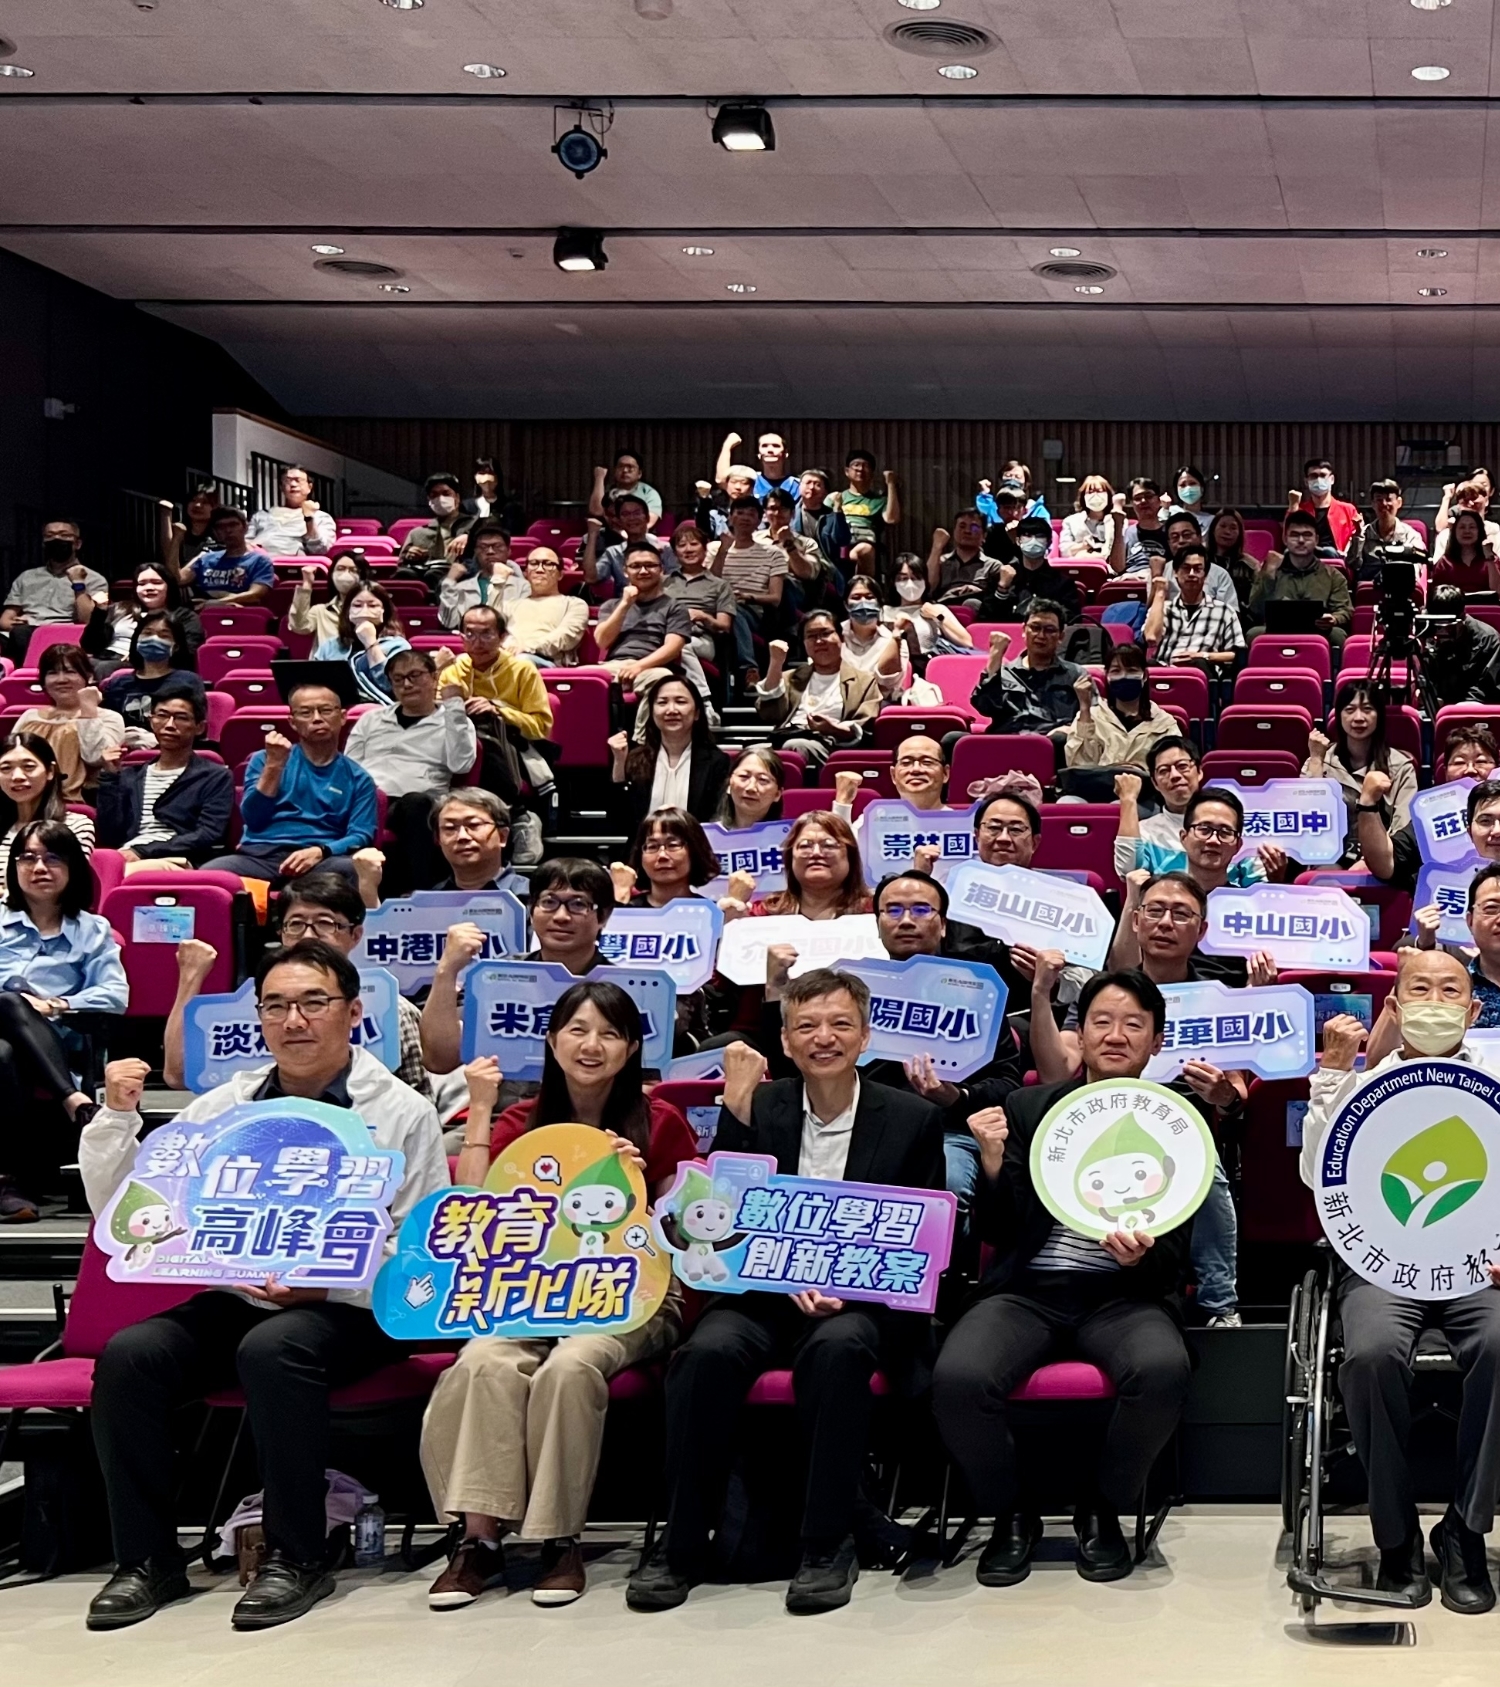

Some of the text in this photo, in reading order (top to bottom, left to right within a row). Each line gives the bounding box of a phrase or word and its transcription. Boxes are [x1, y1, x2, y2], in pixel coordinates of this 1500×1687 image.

[883, 833, 979, 857] 崇林國
[963, 881, 1094, 934] 海山國小
[1223, 911, 1352, 940] 中山國小
[366, 933, 508, 962] 中港小
[1047, 1093, 1189, 1164] 新北市政府教育局
[1326, 1114, 1358, 1178] Education
[1350, 1071, 1424, 1117] Department
[1426, 1067, 1456, 1083] New
[1458, 1073, 1496, 1099] Taipei
[138, 1128, 393, 1201] 數位學習
[191, 1204, 382, 1279] 高峰會
[433, 1193, 553, 1260] 教育
[735, 1187, 925, 1246] 數位學習
[155, 1254, 211, 1264] DIGITAL
[738, 1235, 930, 1294] 創新教案
